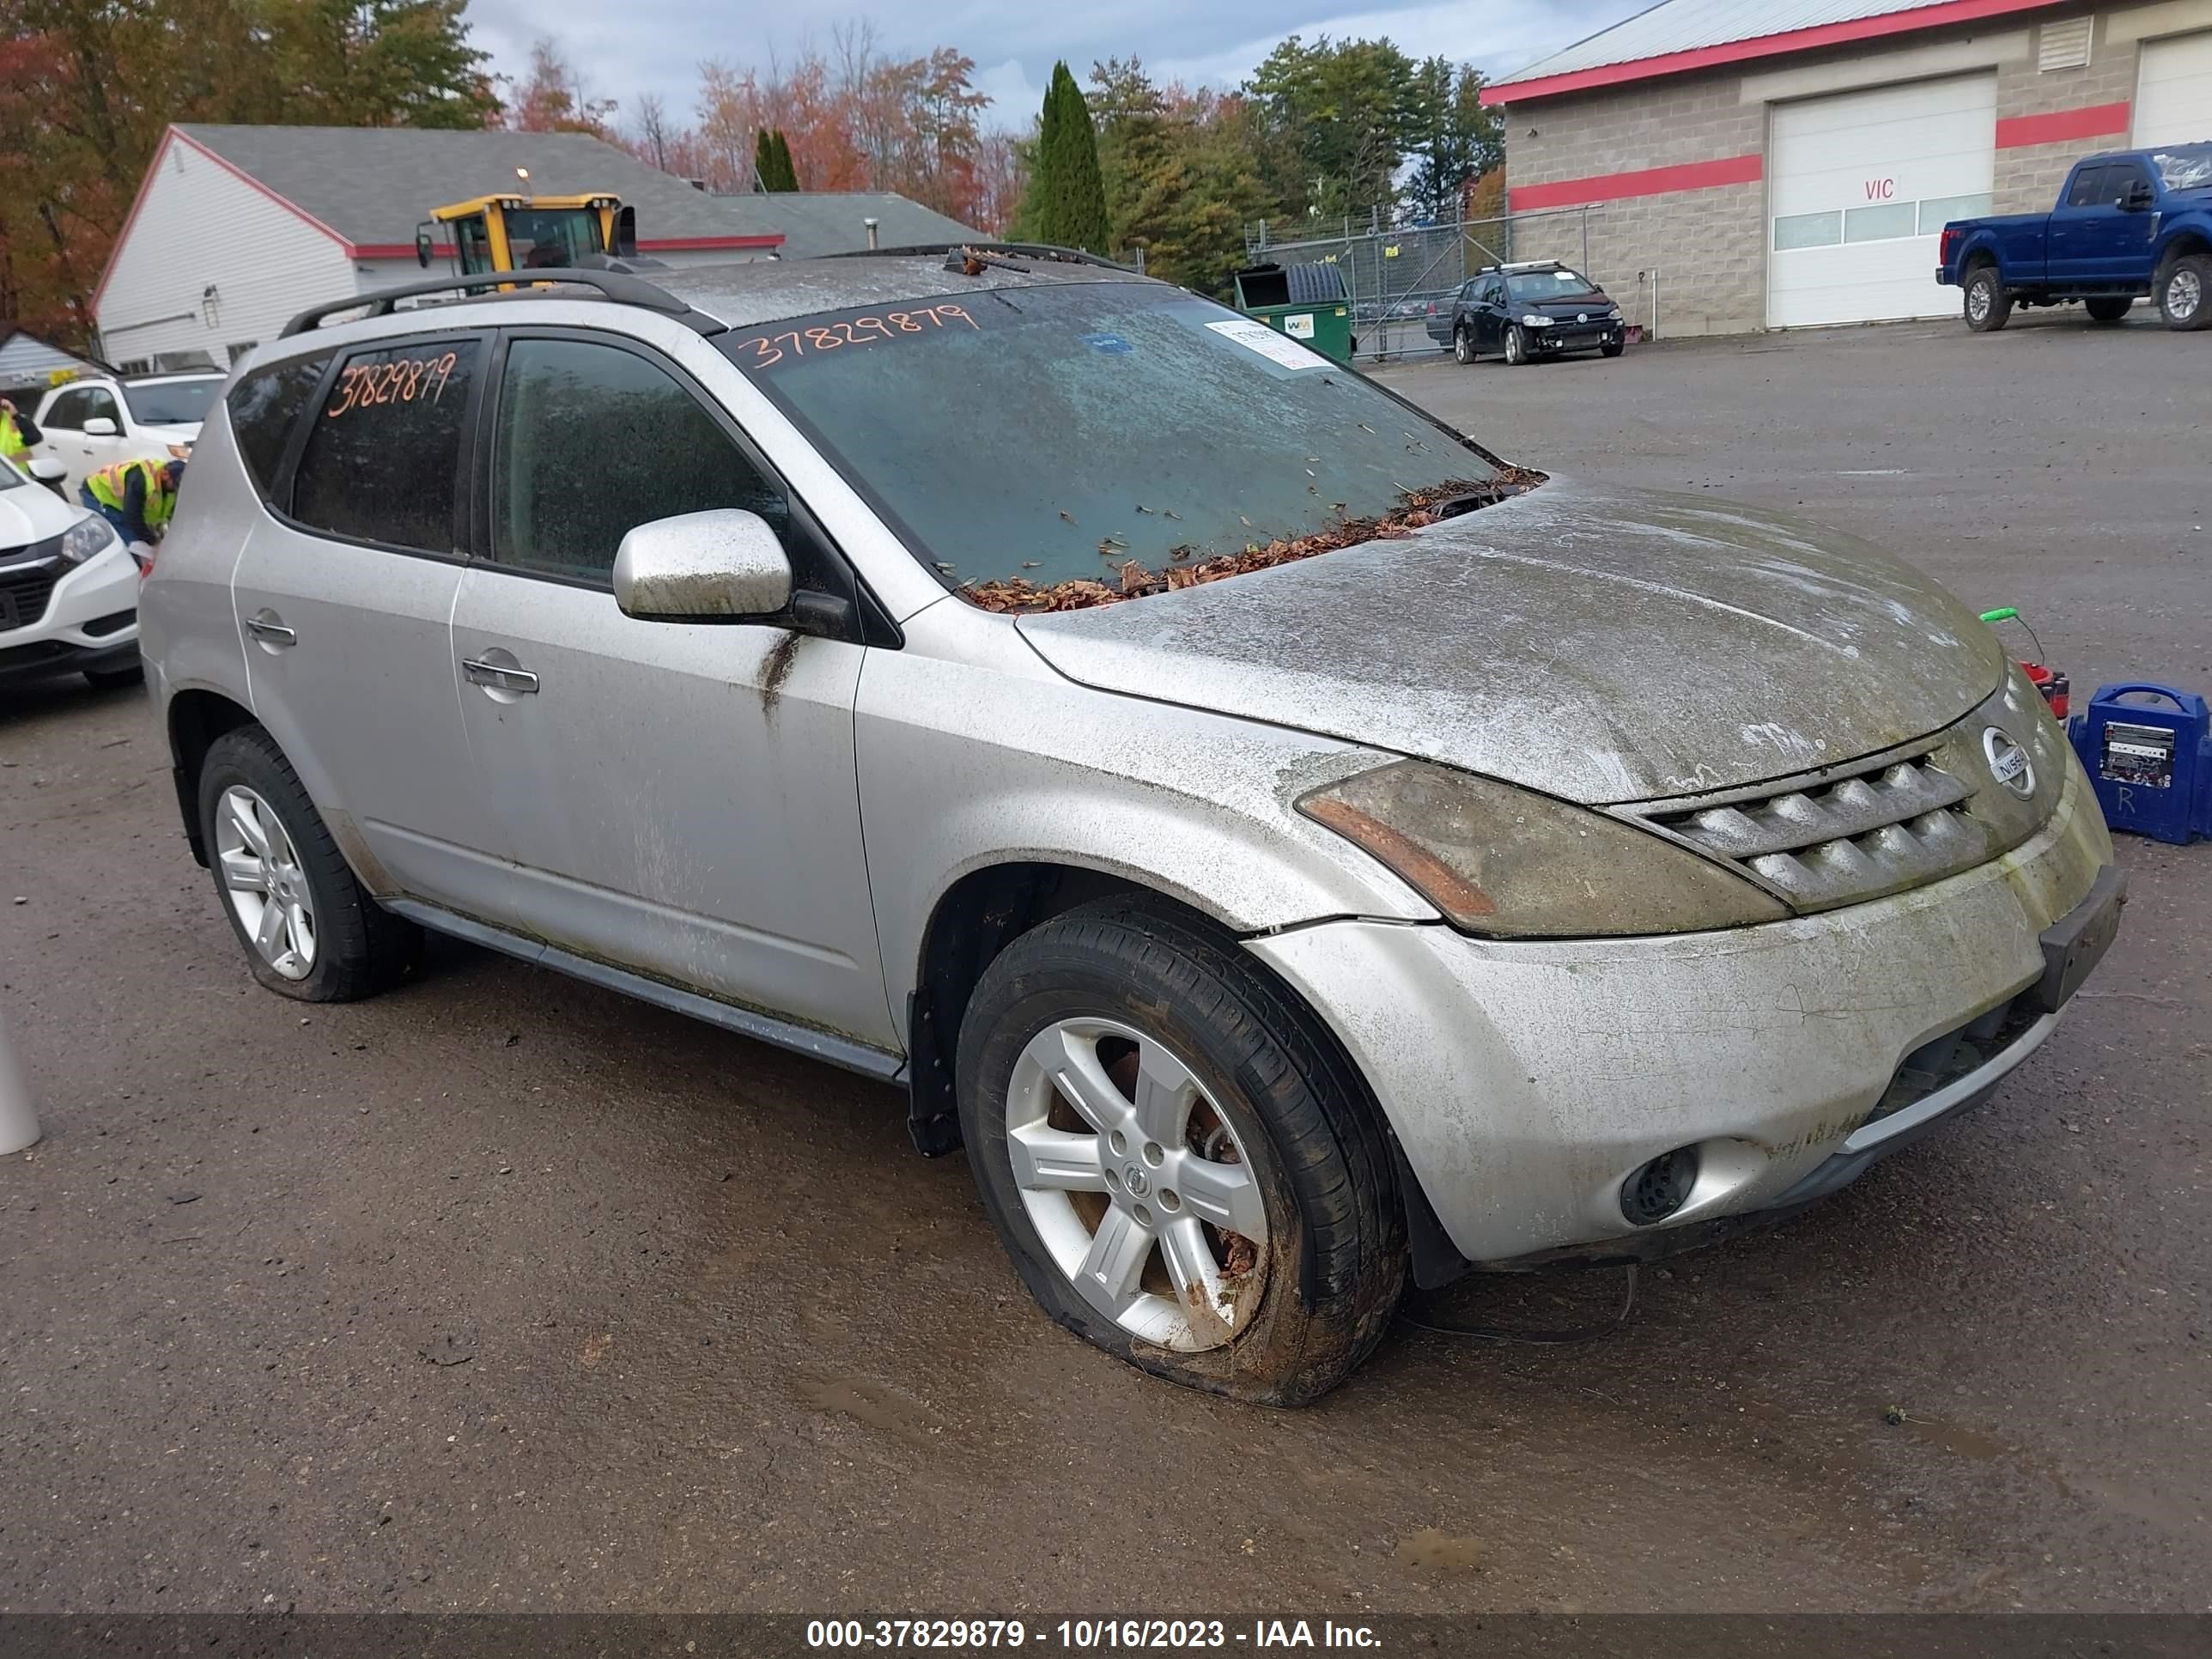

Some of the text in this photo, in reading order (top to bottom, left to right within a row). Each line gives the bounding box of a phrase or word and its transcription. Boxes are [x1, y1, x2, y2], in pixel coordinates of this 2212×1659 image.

[1866, 178, 1893, 199] VIC
[738, 304, 981, 369] 37829879
[1288, 321, 1310, 331] WM
[328, 352, 456, 418] 37829879
[2118, 787, 2136, 813] R
